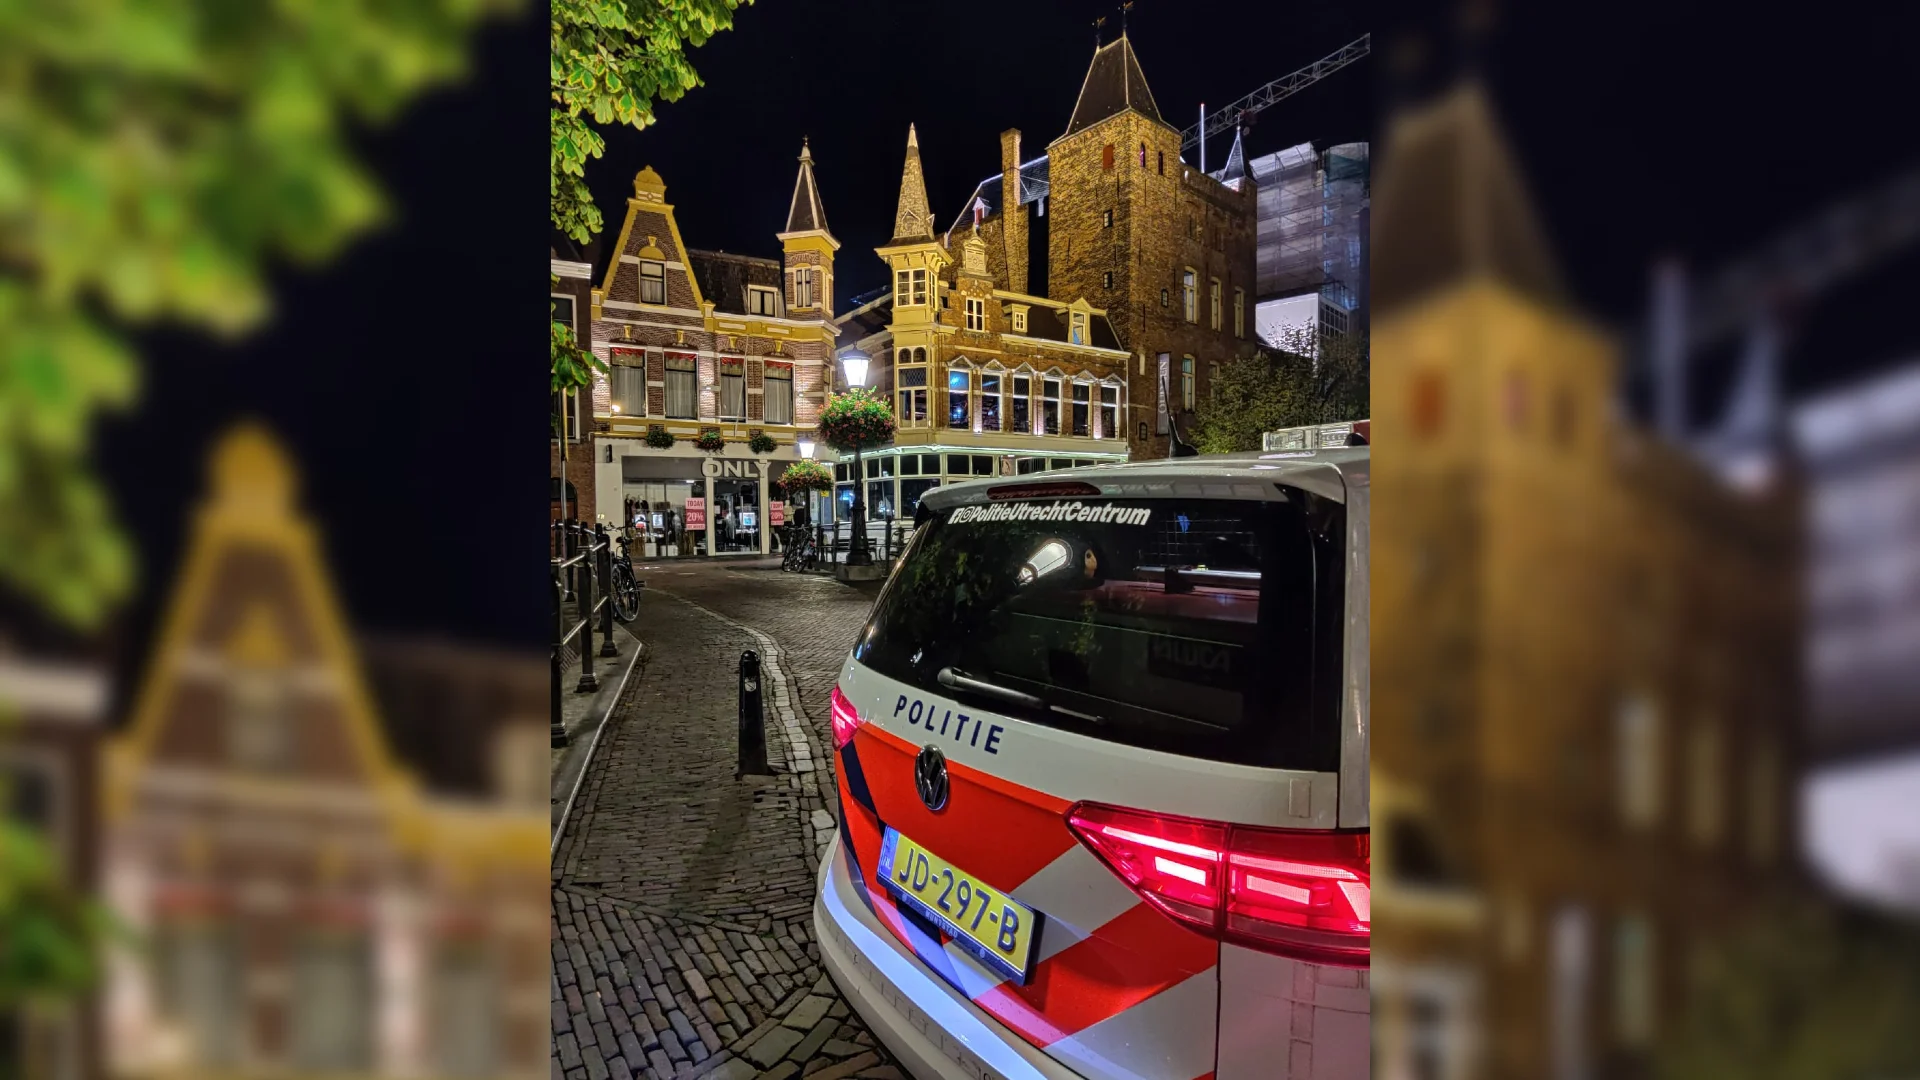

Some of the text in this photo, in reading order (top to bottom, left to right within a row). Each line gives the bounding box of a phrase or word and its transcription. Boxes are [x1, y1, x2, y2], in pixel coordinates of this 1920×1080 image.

[701, 459, 772, 478] ONLY
[687, 511, 704, 522] 20%
[893, 694, 1004, 755] POLITIE
[899, 847, 1020, 953] JD-297-B
